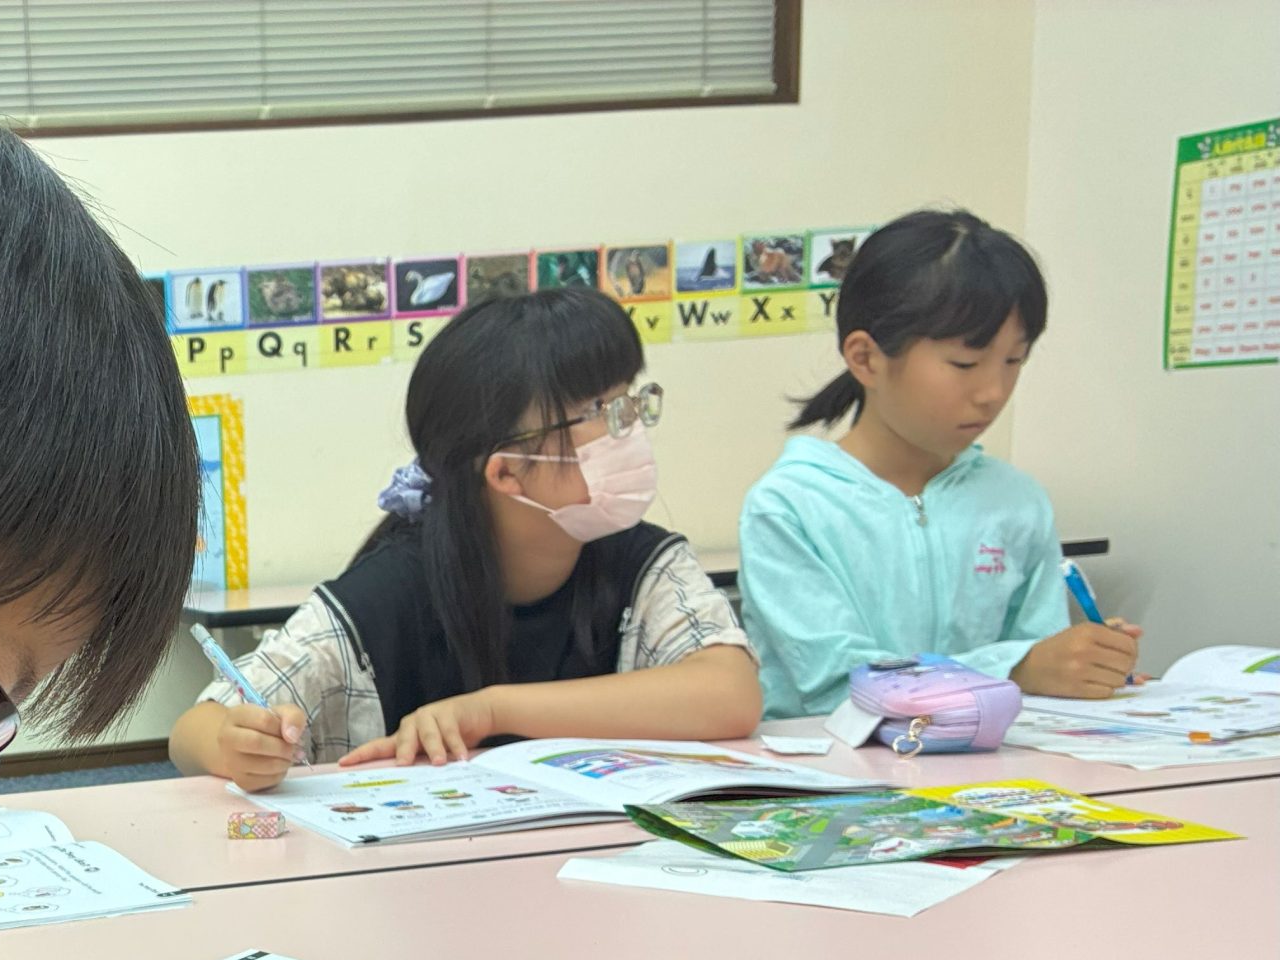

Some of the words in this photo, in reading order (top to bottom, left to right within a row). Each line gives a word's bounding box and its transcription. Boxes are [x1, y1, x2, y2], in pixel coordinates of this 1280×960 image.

[188, 337, 205, 362] P
[220, 347, 234, 372] p
[258, 331, 283, 357] Q
[293, 342, 307, 367] q
[334, 327, 352, 352] R
[367, 337, 378, 350] r
[408, 321, 423, 346] S
[678, 301, 709, 327] W
[710, 310, 731, 325] w
[751, 297, 771, 322] X
[781, 305, 795, 320] x
[820, 293, 835, 316] Y
